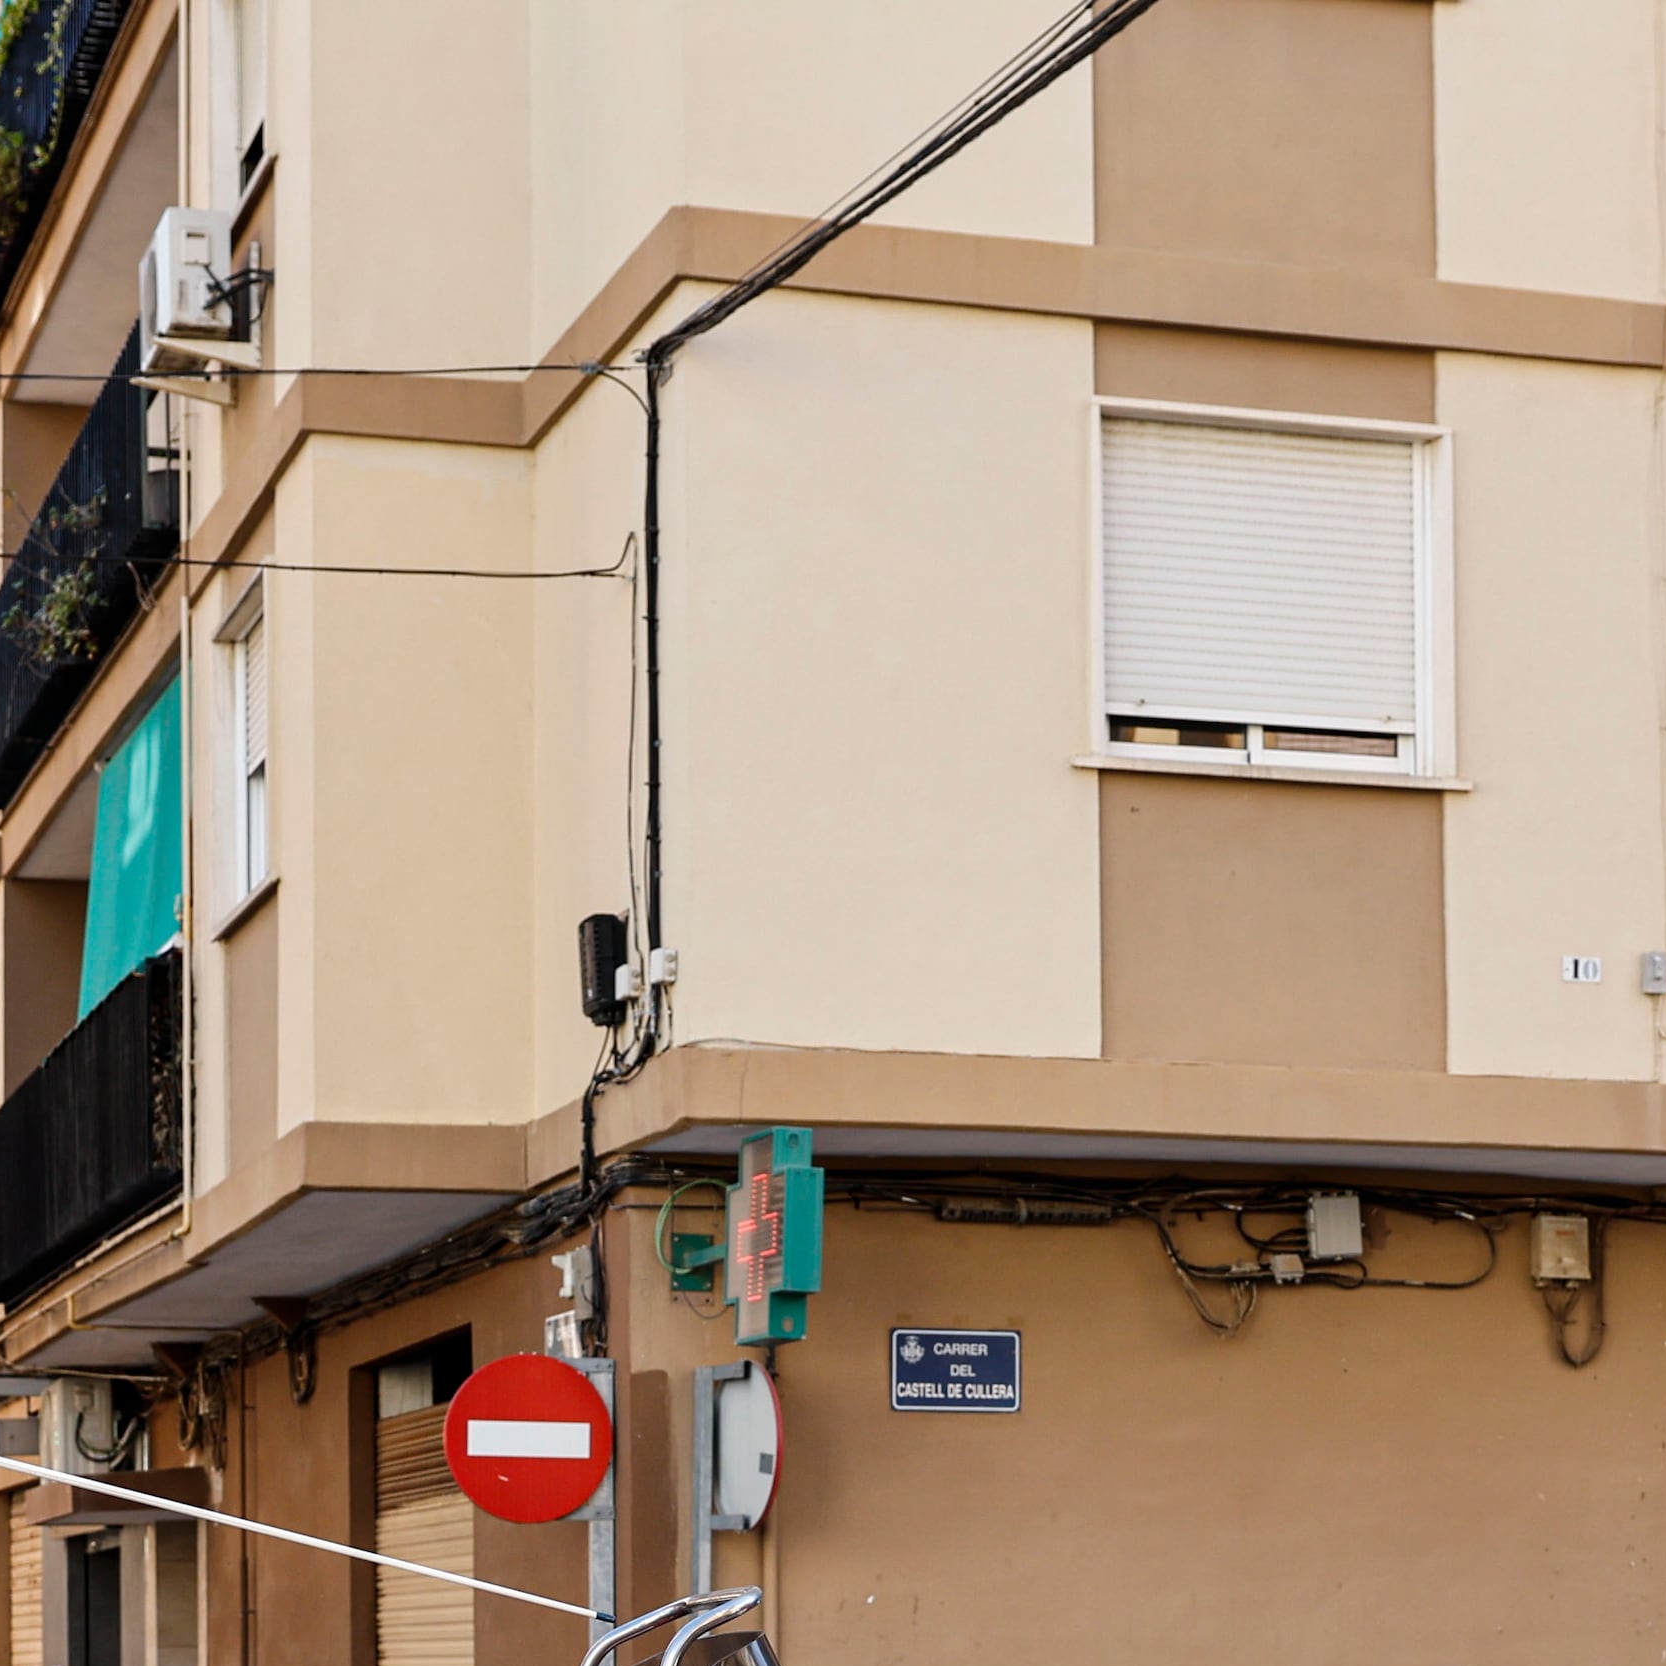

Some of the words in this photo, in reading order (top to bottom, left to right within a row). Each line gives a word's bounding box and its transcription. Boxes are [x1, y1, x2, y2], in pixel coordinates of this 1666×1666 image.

[1572, 958, 1599, 980] 10
[933, 1342, 989, 1356] CARRER
[949, 1364, 976, 1377] DEL
[896, 1381, 946, 1398] CASTELL
[947, 1382, 964, 1399] DE
[964, 1383, 1015, 1399] CULLERA
